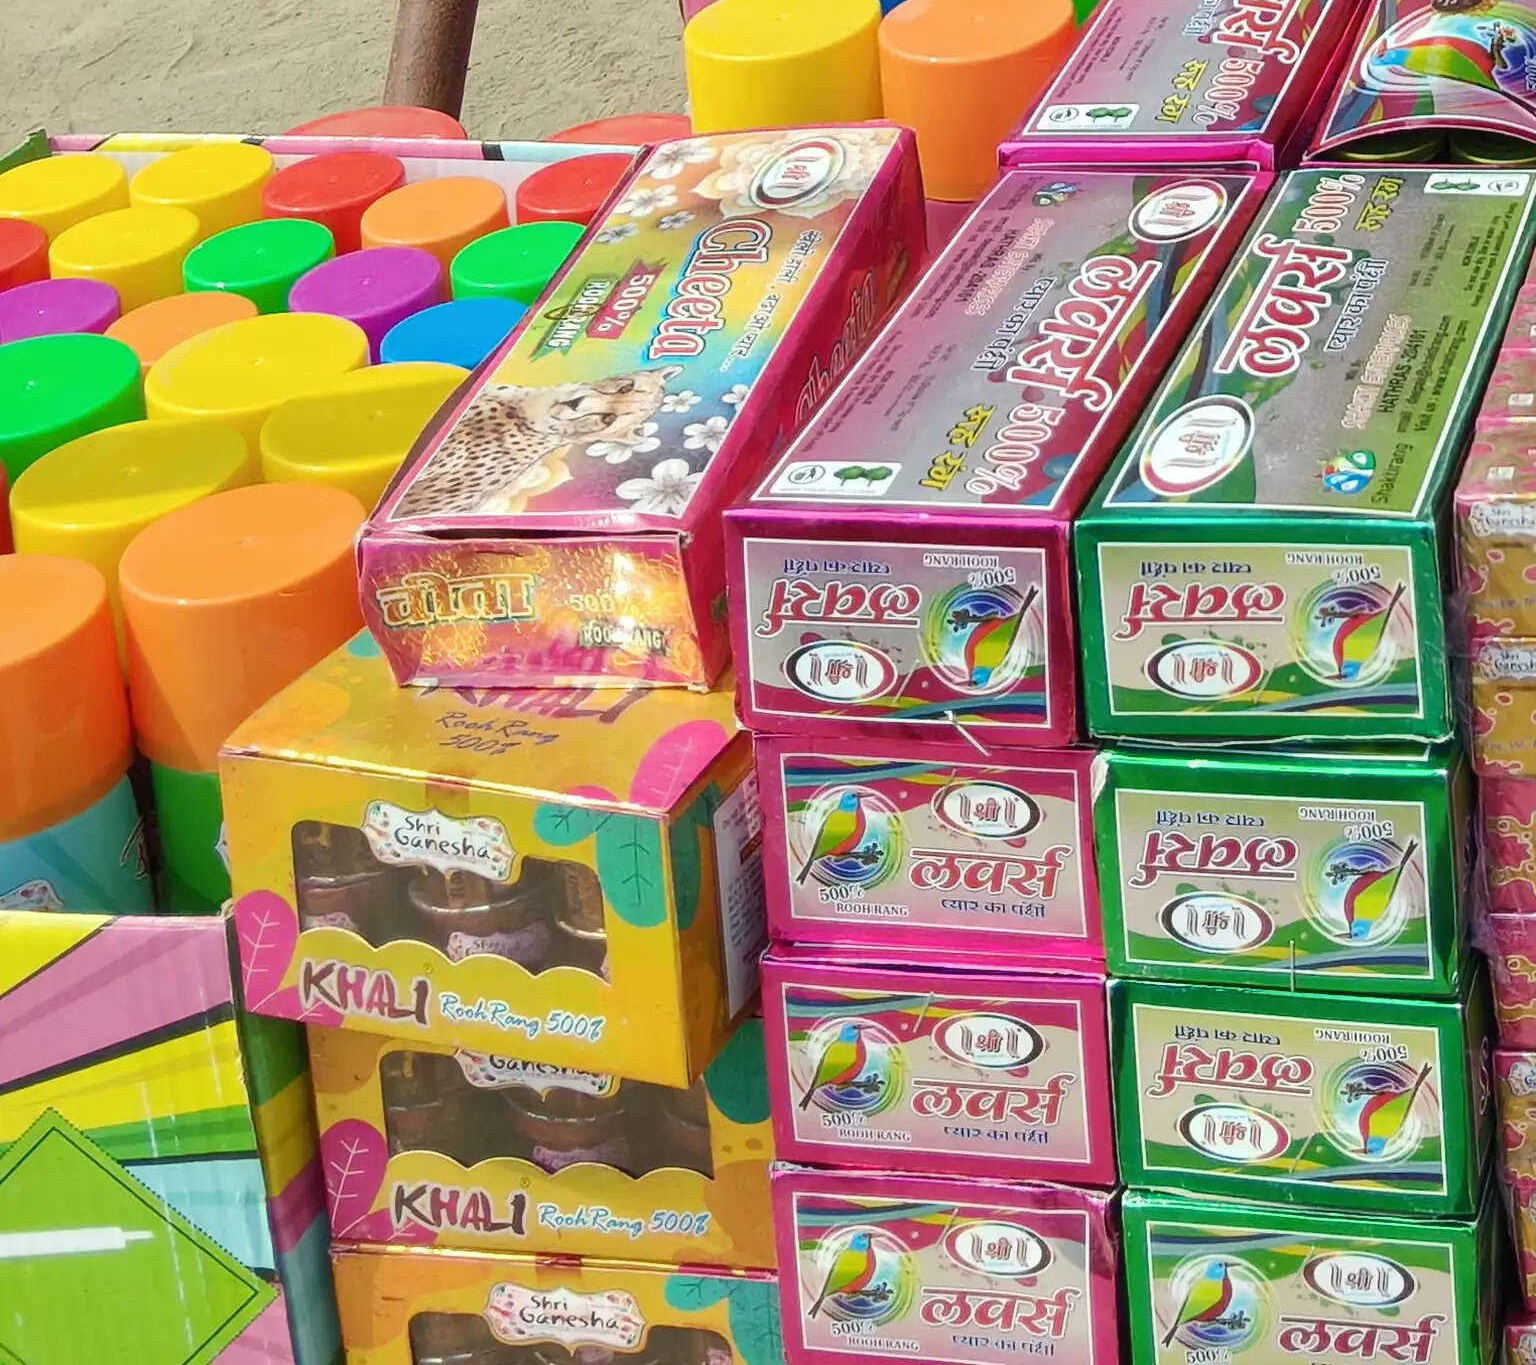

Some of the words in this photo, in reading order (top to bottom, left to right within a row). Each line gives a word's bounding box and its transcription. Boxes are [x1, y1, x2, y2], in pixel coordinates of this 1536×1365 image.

[1192, 57, 1266, 128] 500%
[1212, 233, 1354, 380] लवर्स
[1296, 172, 1368, 239] 500%
[647, 218, 774, 361] Cheeta
[1020, 276, 1056, 311] प्यार
[596, 273, 655, 331] 500%
[554, 311, 592, 350] RANG
[1000, 307, 1026, 339] का
[1323, 317, 1355, 354] प्यार
[1343, 291, 1368, 326] का
[1005, 255, 1162, 412] लवर्स
[1378, 362, 1407, 414] HATHRAS
[965, 404, 1065, 494] 500%
[1372, 442, 1409, 504] Shaktirang
[825, 559, 851, 576] का
[851, 558, 891, 576] प्यार
[923, 553, 960, 567] RANG
[960, 554, 1000, 568] ROOH
[1182, 560, 1207, 577] का
[1211, 559, 1253, 577] प्यार
[1286, 551, 1323, 566] RANG
[1325, 552, 1365, 566] ROOH
[968, 568, 1016, 588] 500%
[1335, 564, 1382, 585] 500%
[757, 578, 922, 637] लवर्स
[1113, 579, 1286, 642] लवर्स
[435, 711, 496, 734] Rooh
[499, 720, 559, 744] Rang
[1198, 813, 1225, 827] का
[1228, 815, 1266, 828] प्यार
[1299, 806, 1336, 820] RANG
[1338, 808, 1377, 822] ROOH
[405, 815, 441, 836] Shri
[1344, 820, 1394, 842] 500%
[394, 828, 493, 862] Ganesha
[1127, 831, 1298, 887] लवर्स
[910, 844, 1073, 900] लवर्स
[818, 884, 866, 905] 500%
[835, 902, 872, 916] ROOH
[873, 904, 910, 918] RANG
[940, 898, 979, 914] प्यार
[983, 901, 1007, 917] का
[301, 957, 430, 1024] KHALI
[440, 993, 491, 1023] Rooh
[491, 1001, 541, 1037] Rang
[545, 1009, 604, 1041] 500%
[1214, 1028, 1241, 1043] का
[1243, 1031, 1282, 1046] प्यार
[1314, 1028, 1353, 1042] RANG
[1354, 1030, 1392, 1045] ROOH
[1359, 1044, 1410, 1064] 500%
[1149, 1043, 1315, 1098] लवर्स
[911, 1074, 1076, 1129] लवर्स
[821, 1110, 866, 1130] 500%
[837, 1127, 875, 1141] ROOH
[875, 1129, 912, 1144] RANG
[943, 1125, 982, 1141] प्यार
[987, 1128, 1010, 1144] का
[393, 1182, 527, 1236] KHALI
[538, 1202, 590, 1229] Rooh
[590, 1208, 643, 1237] Rang
[649, 1208, 709, 1236] 500%
[528, 1296, 568, 1313] Shri
[920, 1283, 1083, 1339] लवर्स
[518, 1309, 619, 1332] Ganesha
[830, 1318, 875, 1337] 500%
[847, 1335, 884, 1350] ROOH
[884, 1337, 920, 1353] RANG
[950, 1332, 989, 1349] प्यार
[993, 1336, 1017, 1353] का
[1277, 1312, 1442, 1364] लवर्स
